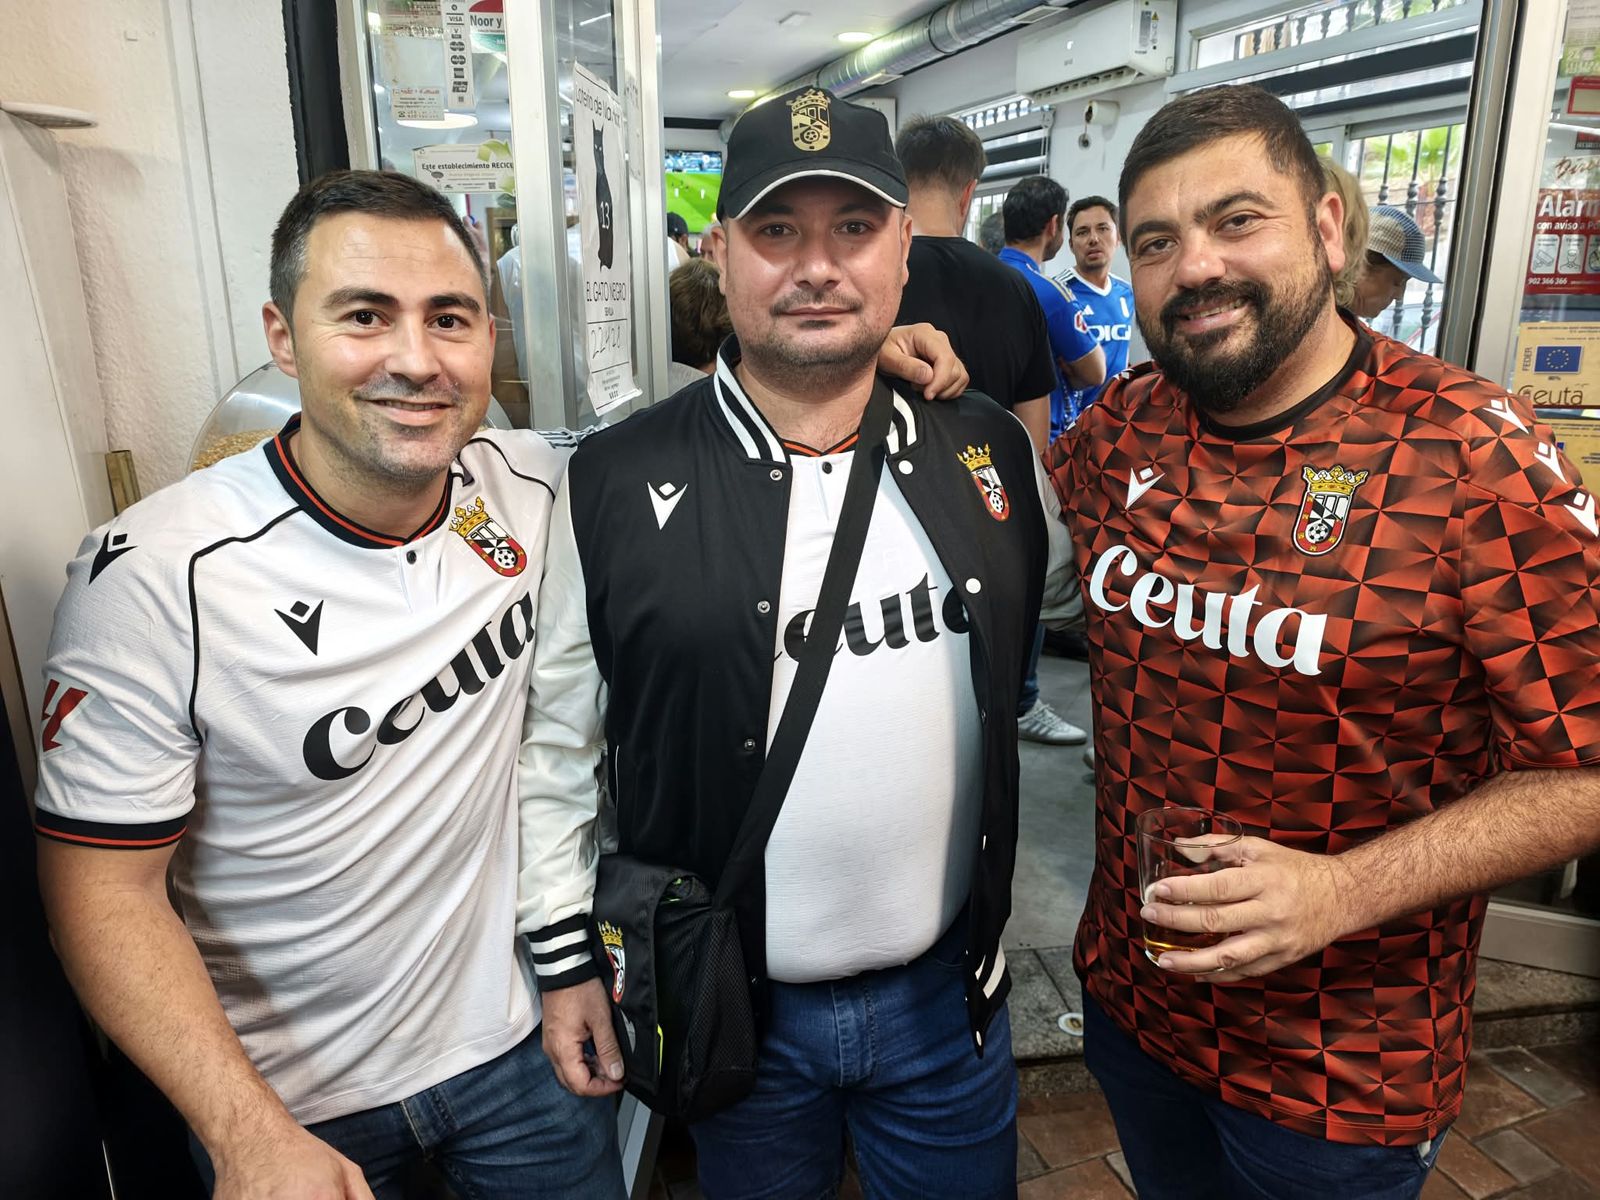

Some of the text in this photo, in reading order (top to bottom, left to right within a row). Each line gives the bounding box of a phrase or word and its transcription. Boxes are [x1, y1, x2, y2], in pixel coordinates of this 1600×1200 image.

[470, 15, 502, 28] Noor y
[438, 161, 490, 170] establecimiento
[600, 202, 610, 229] 13
[1536, 221, 1552, 231] con
[1554, 219, 1578, 231] aviso
[586, 281, 626, 301] EL GATO NEGRO
[1522, 346, 1532, 371] FEDER
